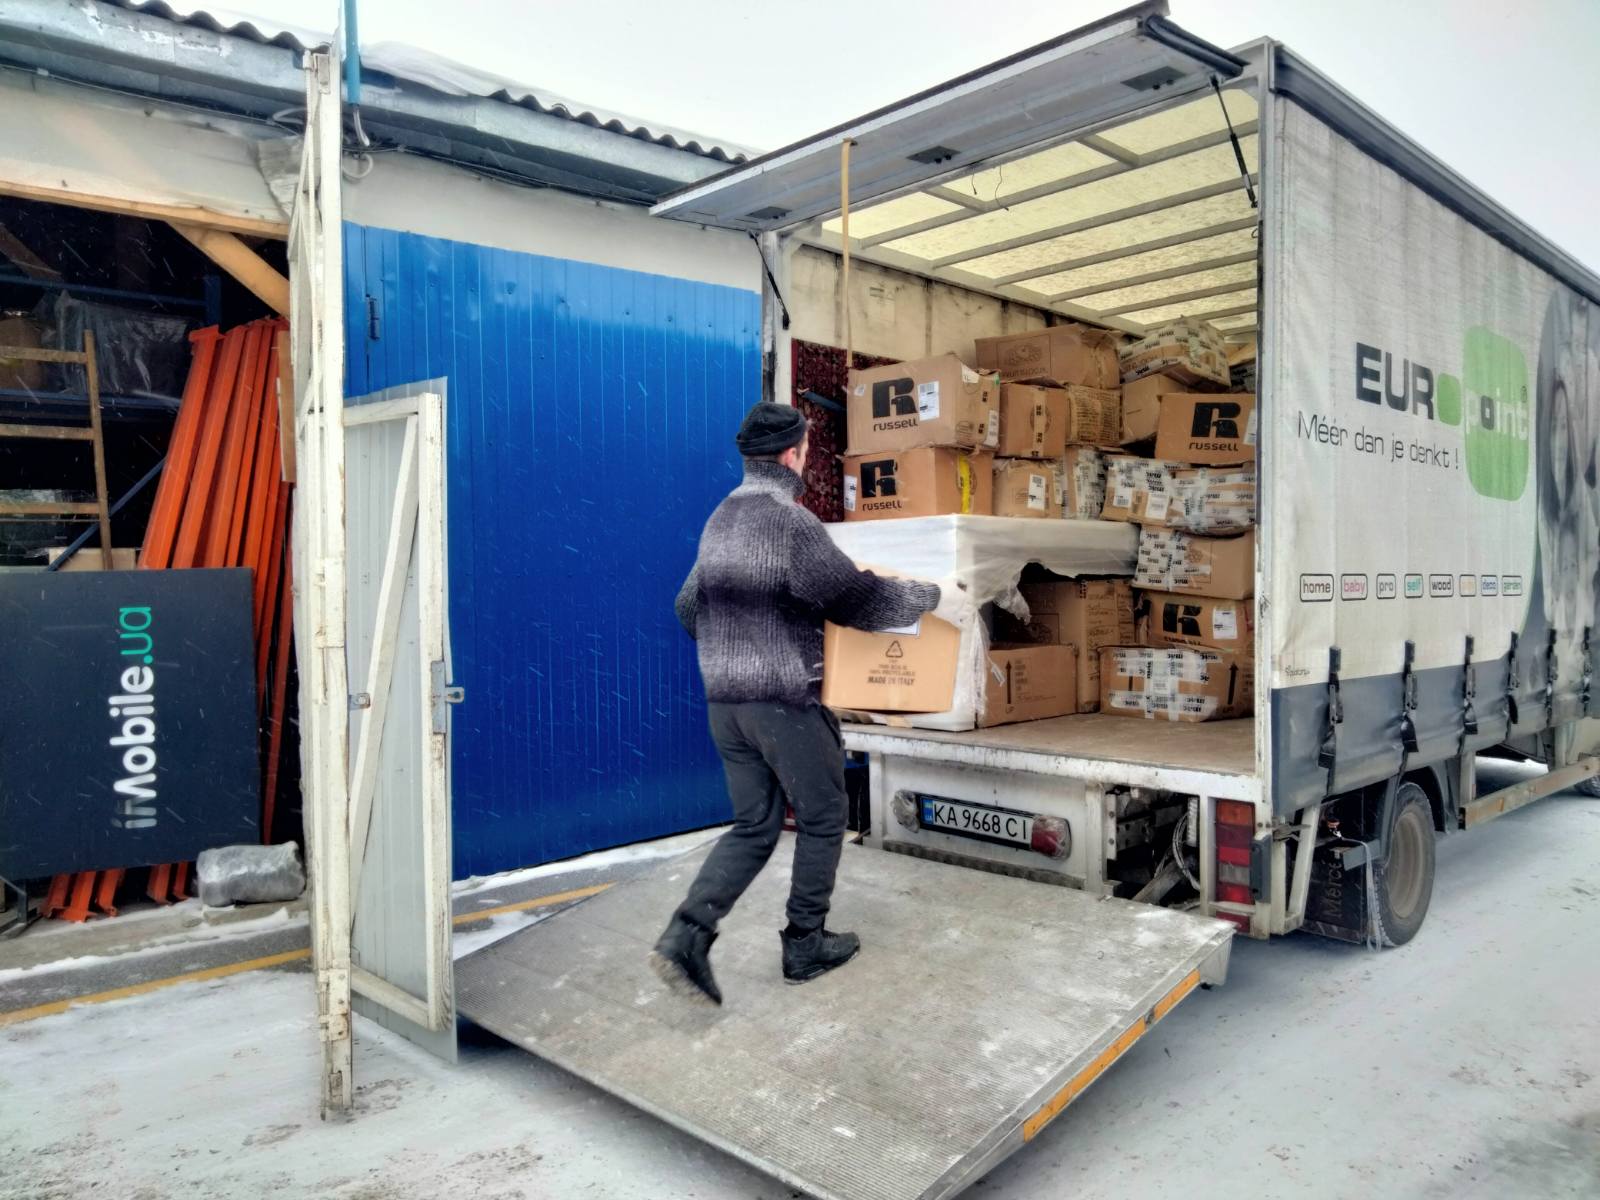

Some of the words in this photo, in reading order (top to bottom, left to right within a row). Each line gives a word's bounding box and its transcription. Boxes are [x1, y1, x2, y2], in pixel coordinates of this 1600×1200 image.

[873, 418, 918, 432] russell
[1188, 442, 1239, 452] russell
[1355, 426, 1384, 456] dan
[1391, 432, 1404, 462] je
[1409, 438, 1449, 468] denkt
[862, 500, 902, 511] russell
[1303, 579, 1331, 593] home
[1344, 580, 1365, 595] baby
[1379, 582, 1393, 594] pro
[1432, 579, 1451, 590] wood
[934, 803, 958, 826] KA
[962, 809, 1001, 834] 9668
[1005, 817, 1026, 840] CI
